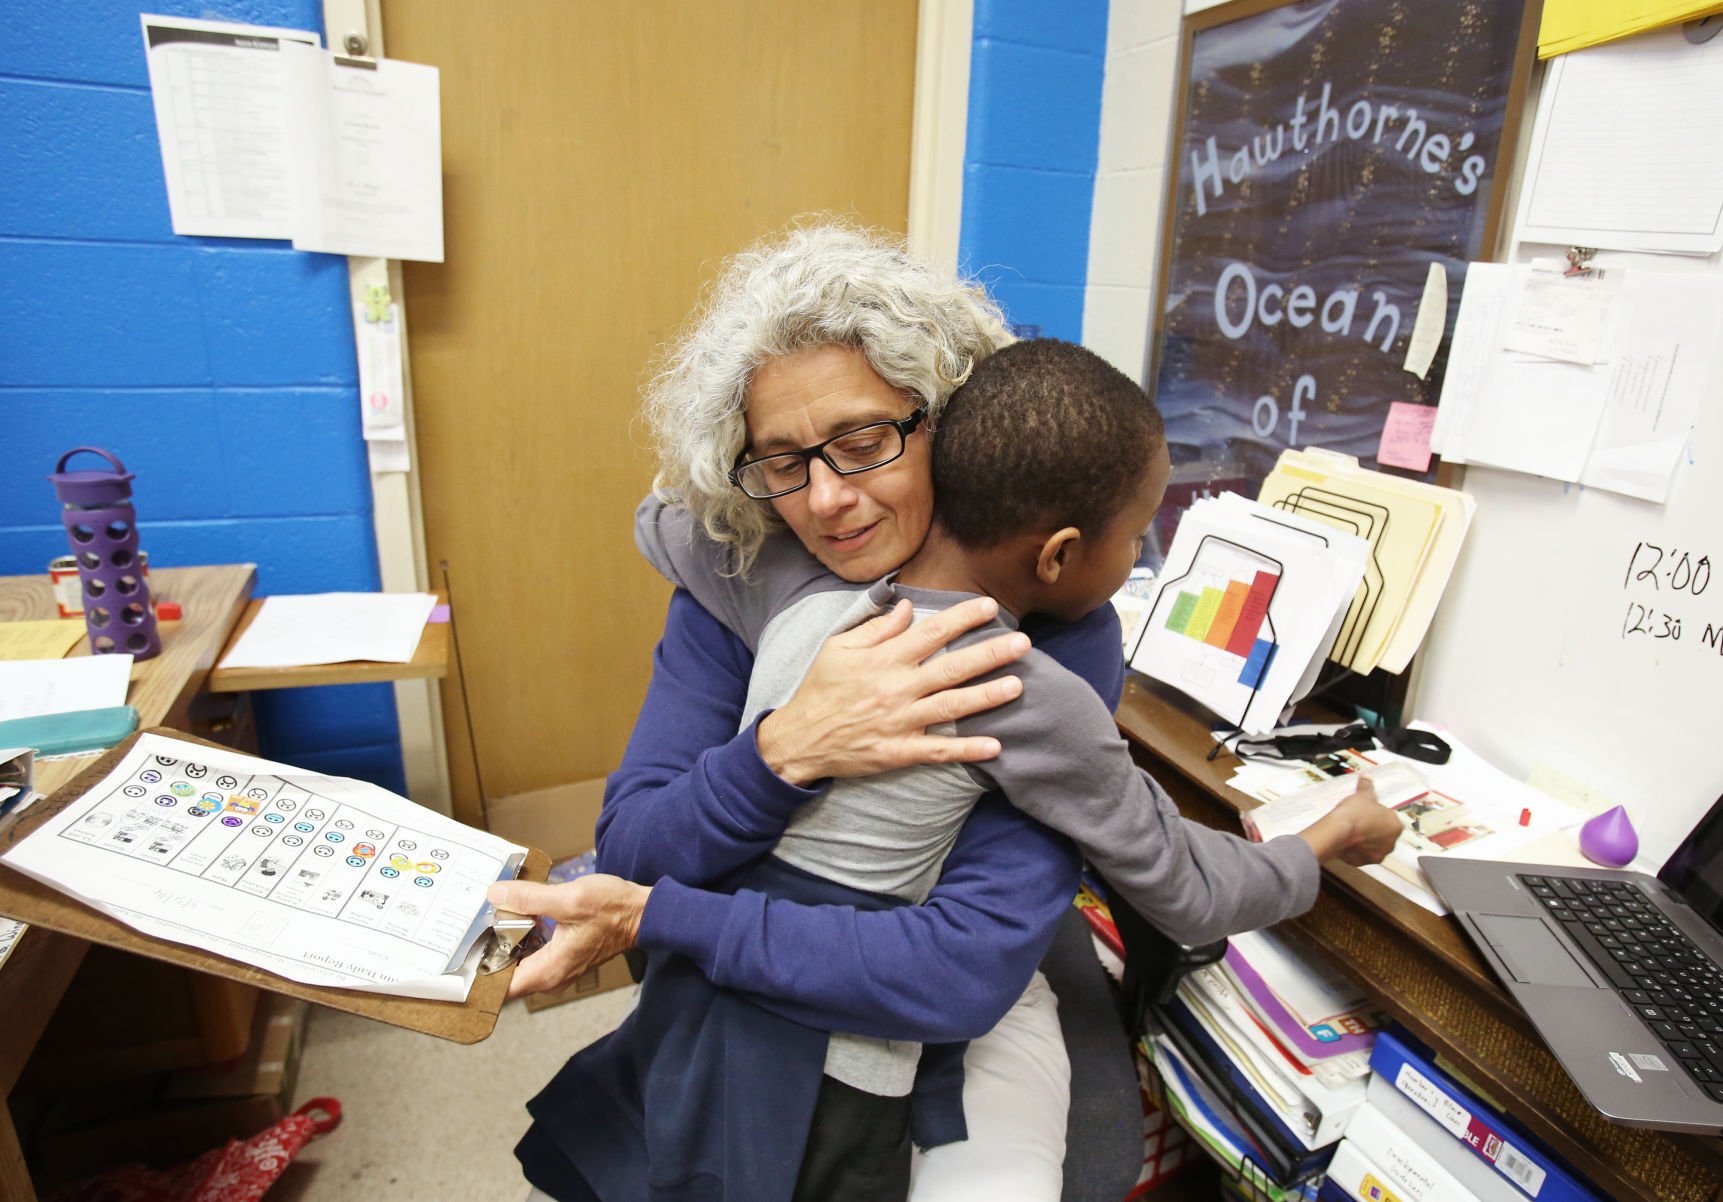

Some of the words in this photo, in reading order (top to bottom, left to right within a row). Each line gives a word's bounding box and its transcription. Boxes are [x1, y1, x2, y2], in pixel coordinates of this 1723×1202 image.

[1191, 82, 1485, 216] Hawthorne's
[1214, 262, 1400, 353] Ocean
[1252, 374, 1316, 446] of
[1623, 541, 1711, 596] 12:00
[1622, 601, 1681, 641] 12:30
